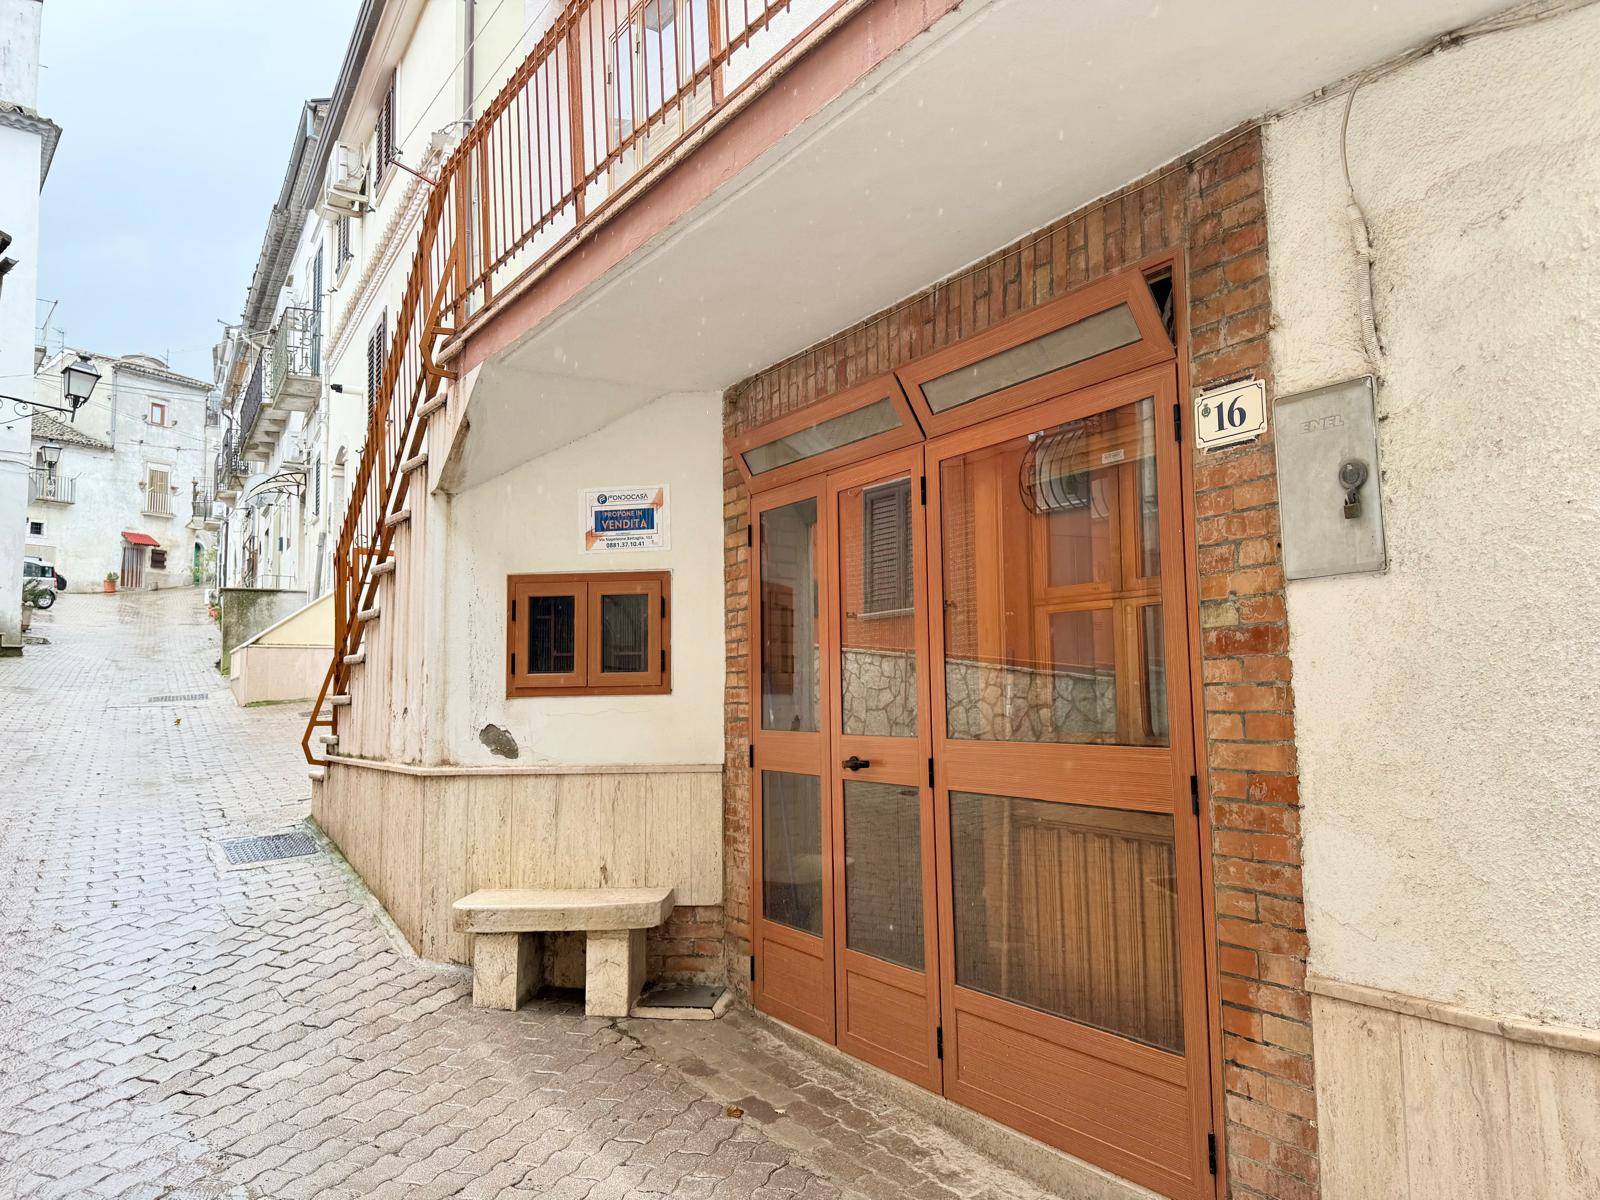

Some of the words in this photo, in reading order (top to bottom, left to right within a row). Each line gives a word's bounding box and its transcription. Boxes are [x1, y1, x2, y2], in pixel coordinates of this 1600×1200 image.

[1214, 394, 1246, 432] 16
[1300, 414, 1345, 434] ENEL
[602, 519, 647, 530] VENDITA
